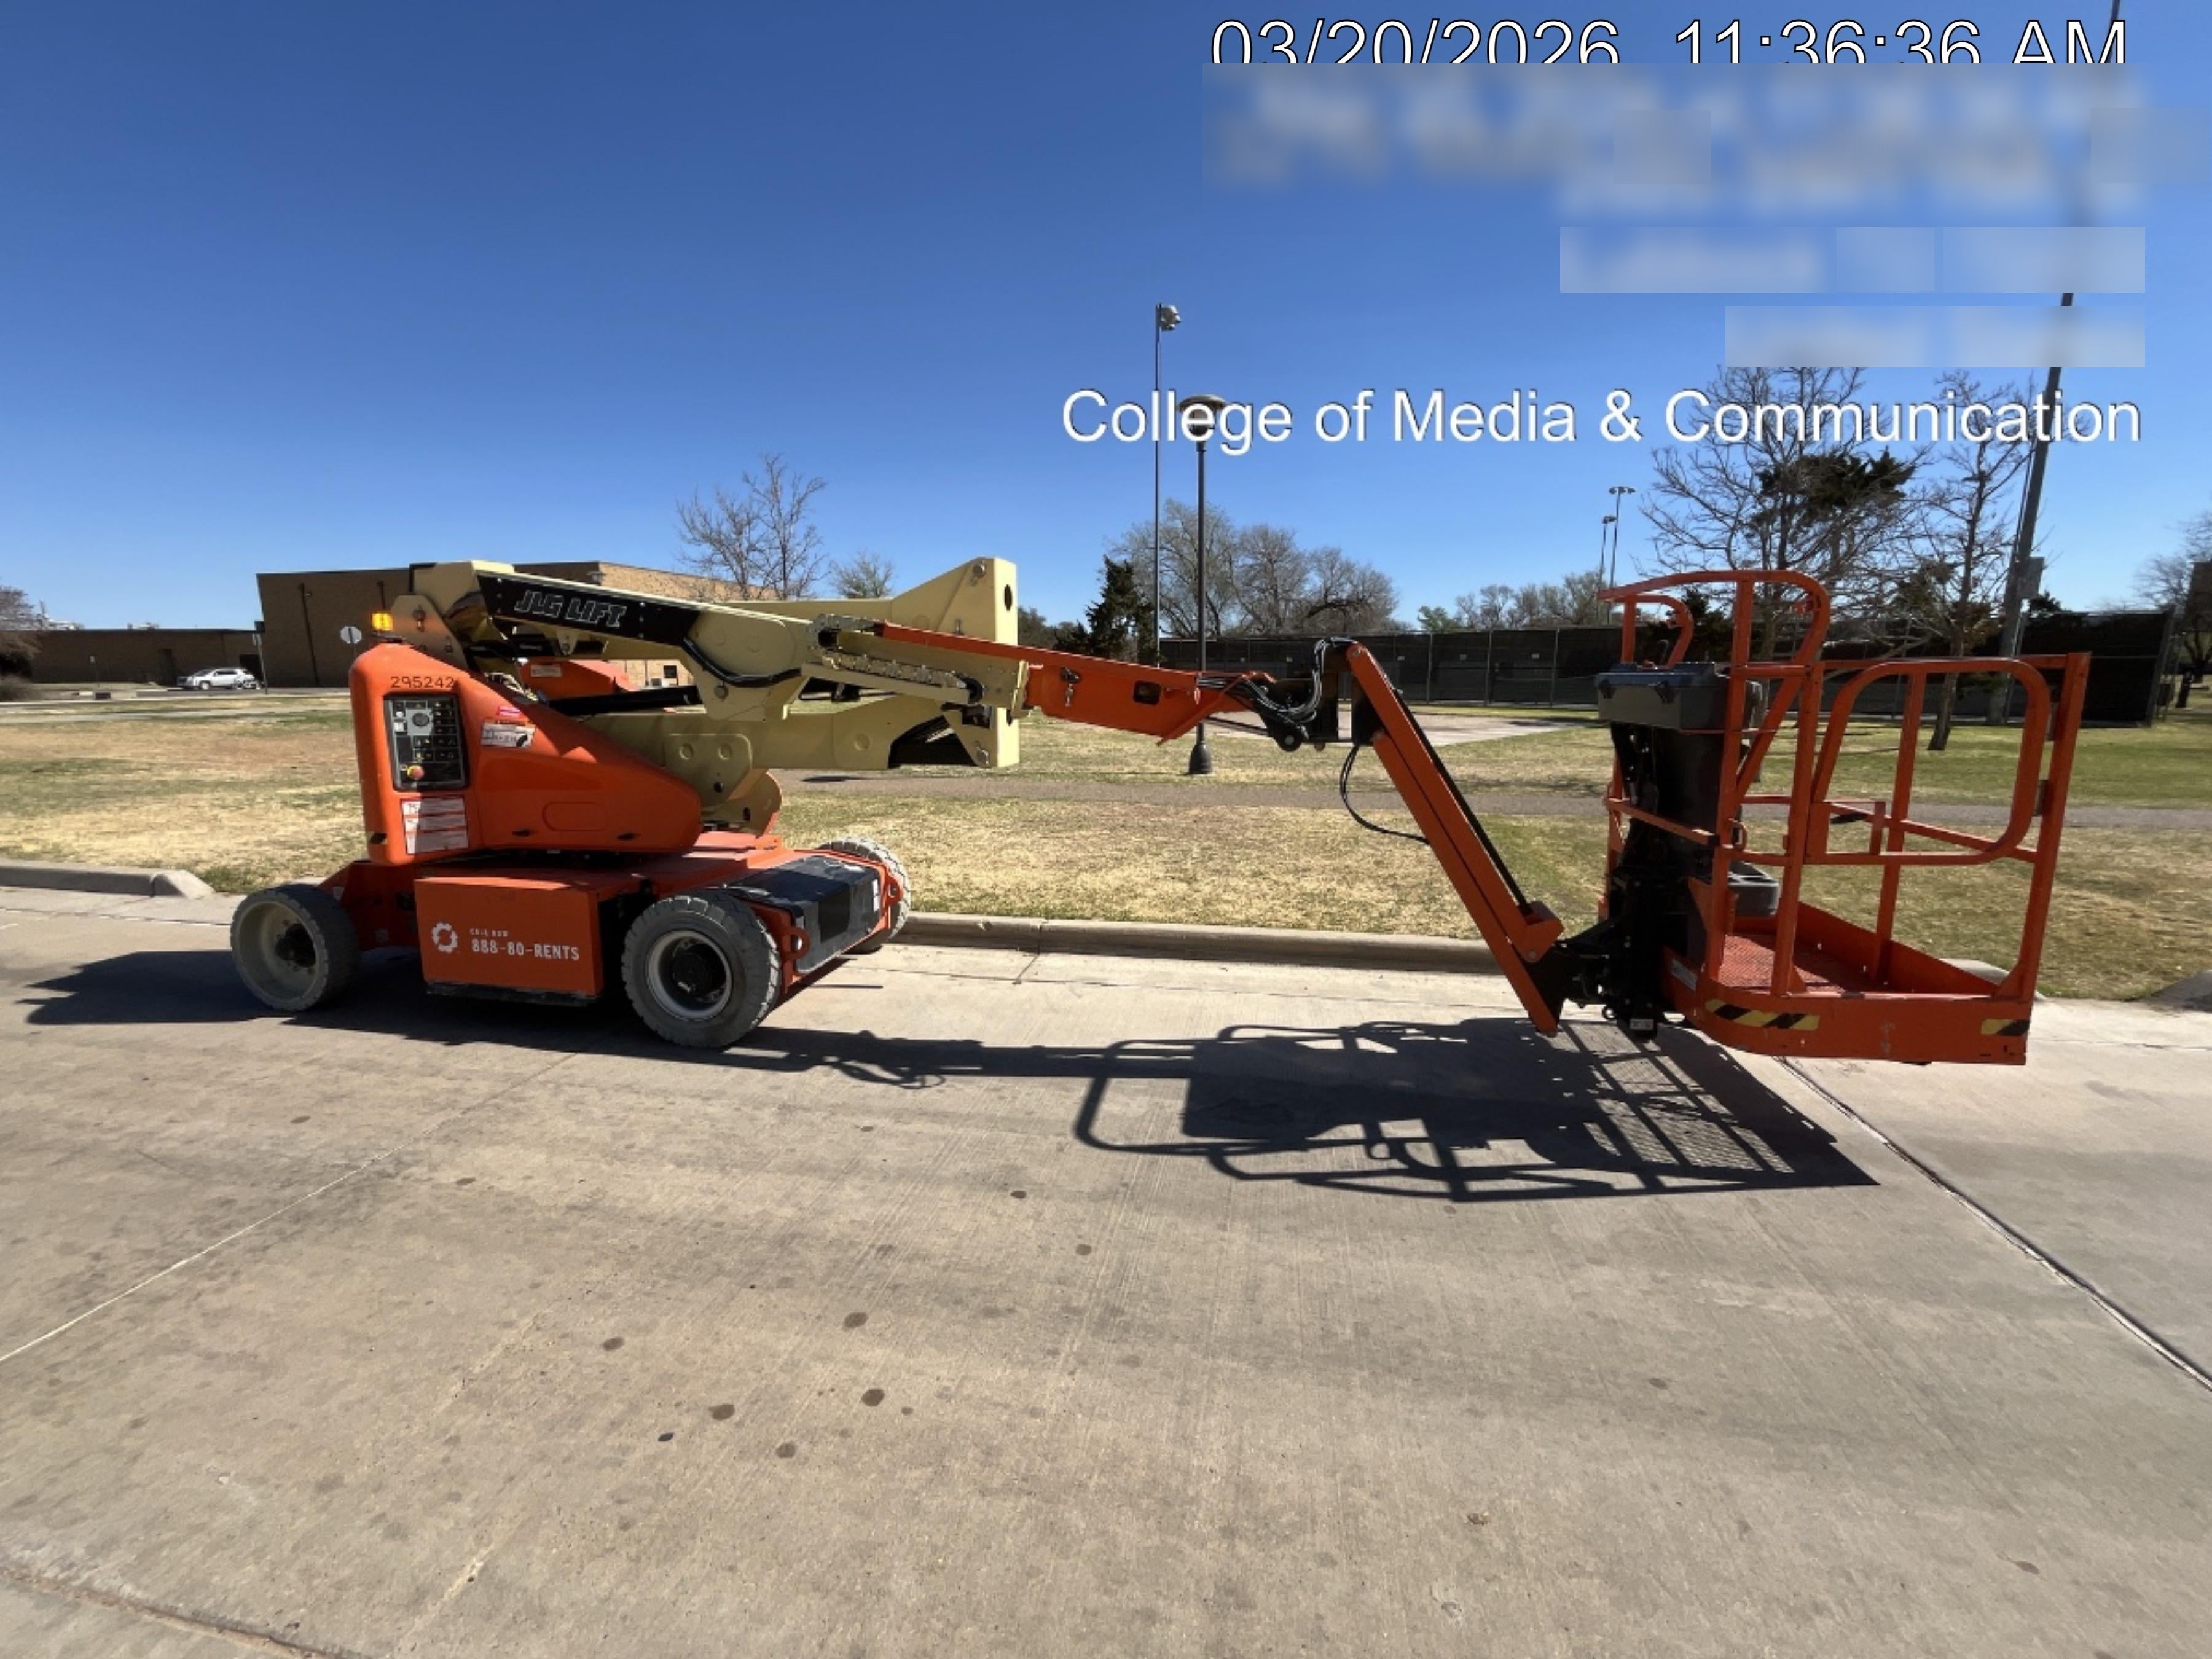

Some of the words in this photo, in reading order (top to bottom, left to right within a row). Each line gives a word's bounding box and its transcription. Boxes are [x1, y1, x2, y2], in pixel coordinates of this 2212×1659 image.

[514, 590, 564, 618] JLG
[565, 597, 627, 627] LIFT
[390, 676, 454, 688] 295242
[471, 938, 579, 960] 888-80-RENTS
